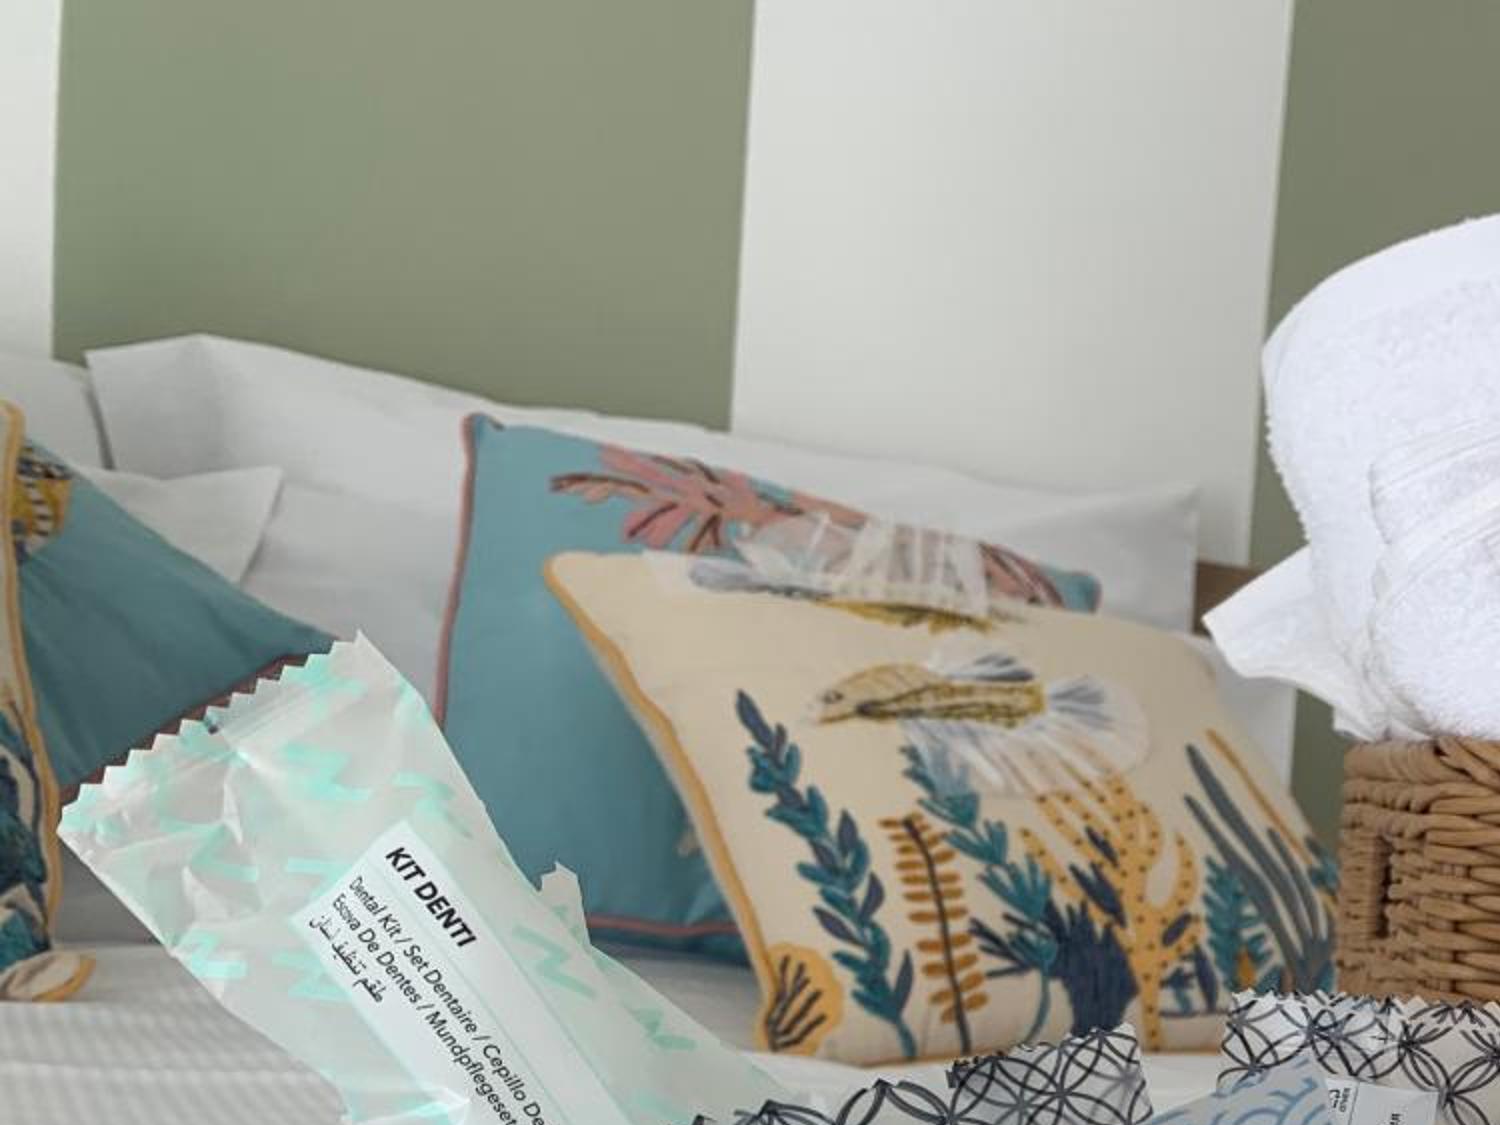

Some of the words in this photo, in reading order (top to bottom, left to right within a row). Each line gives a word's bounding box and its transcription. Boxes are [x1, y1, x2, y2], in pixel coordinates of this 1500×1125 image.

[386, 848, 425, 880] KIT
[414, 882, 476, 946] DENTI
[350, 876, 387, 915] Dental
[378, 914, 401, 938] Kit
[403, 945, 429, 972] Set
[423, 969, 477, 1032] Dentaire
[483, 1044, 526, 1101] Cepillo
[358, 928, 379, 952] De
[376, 951, 422, 1003] Dentes
